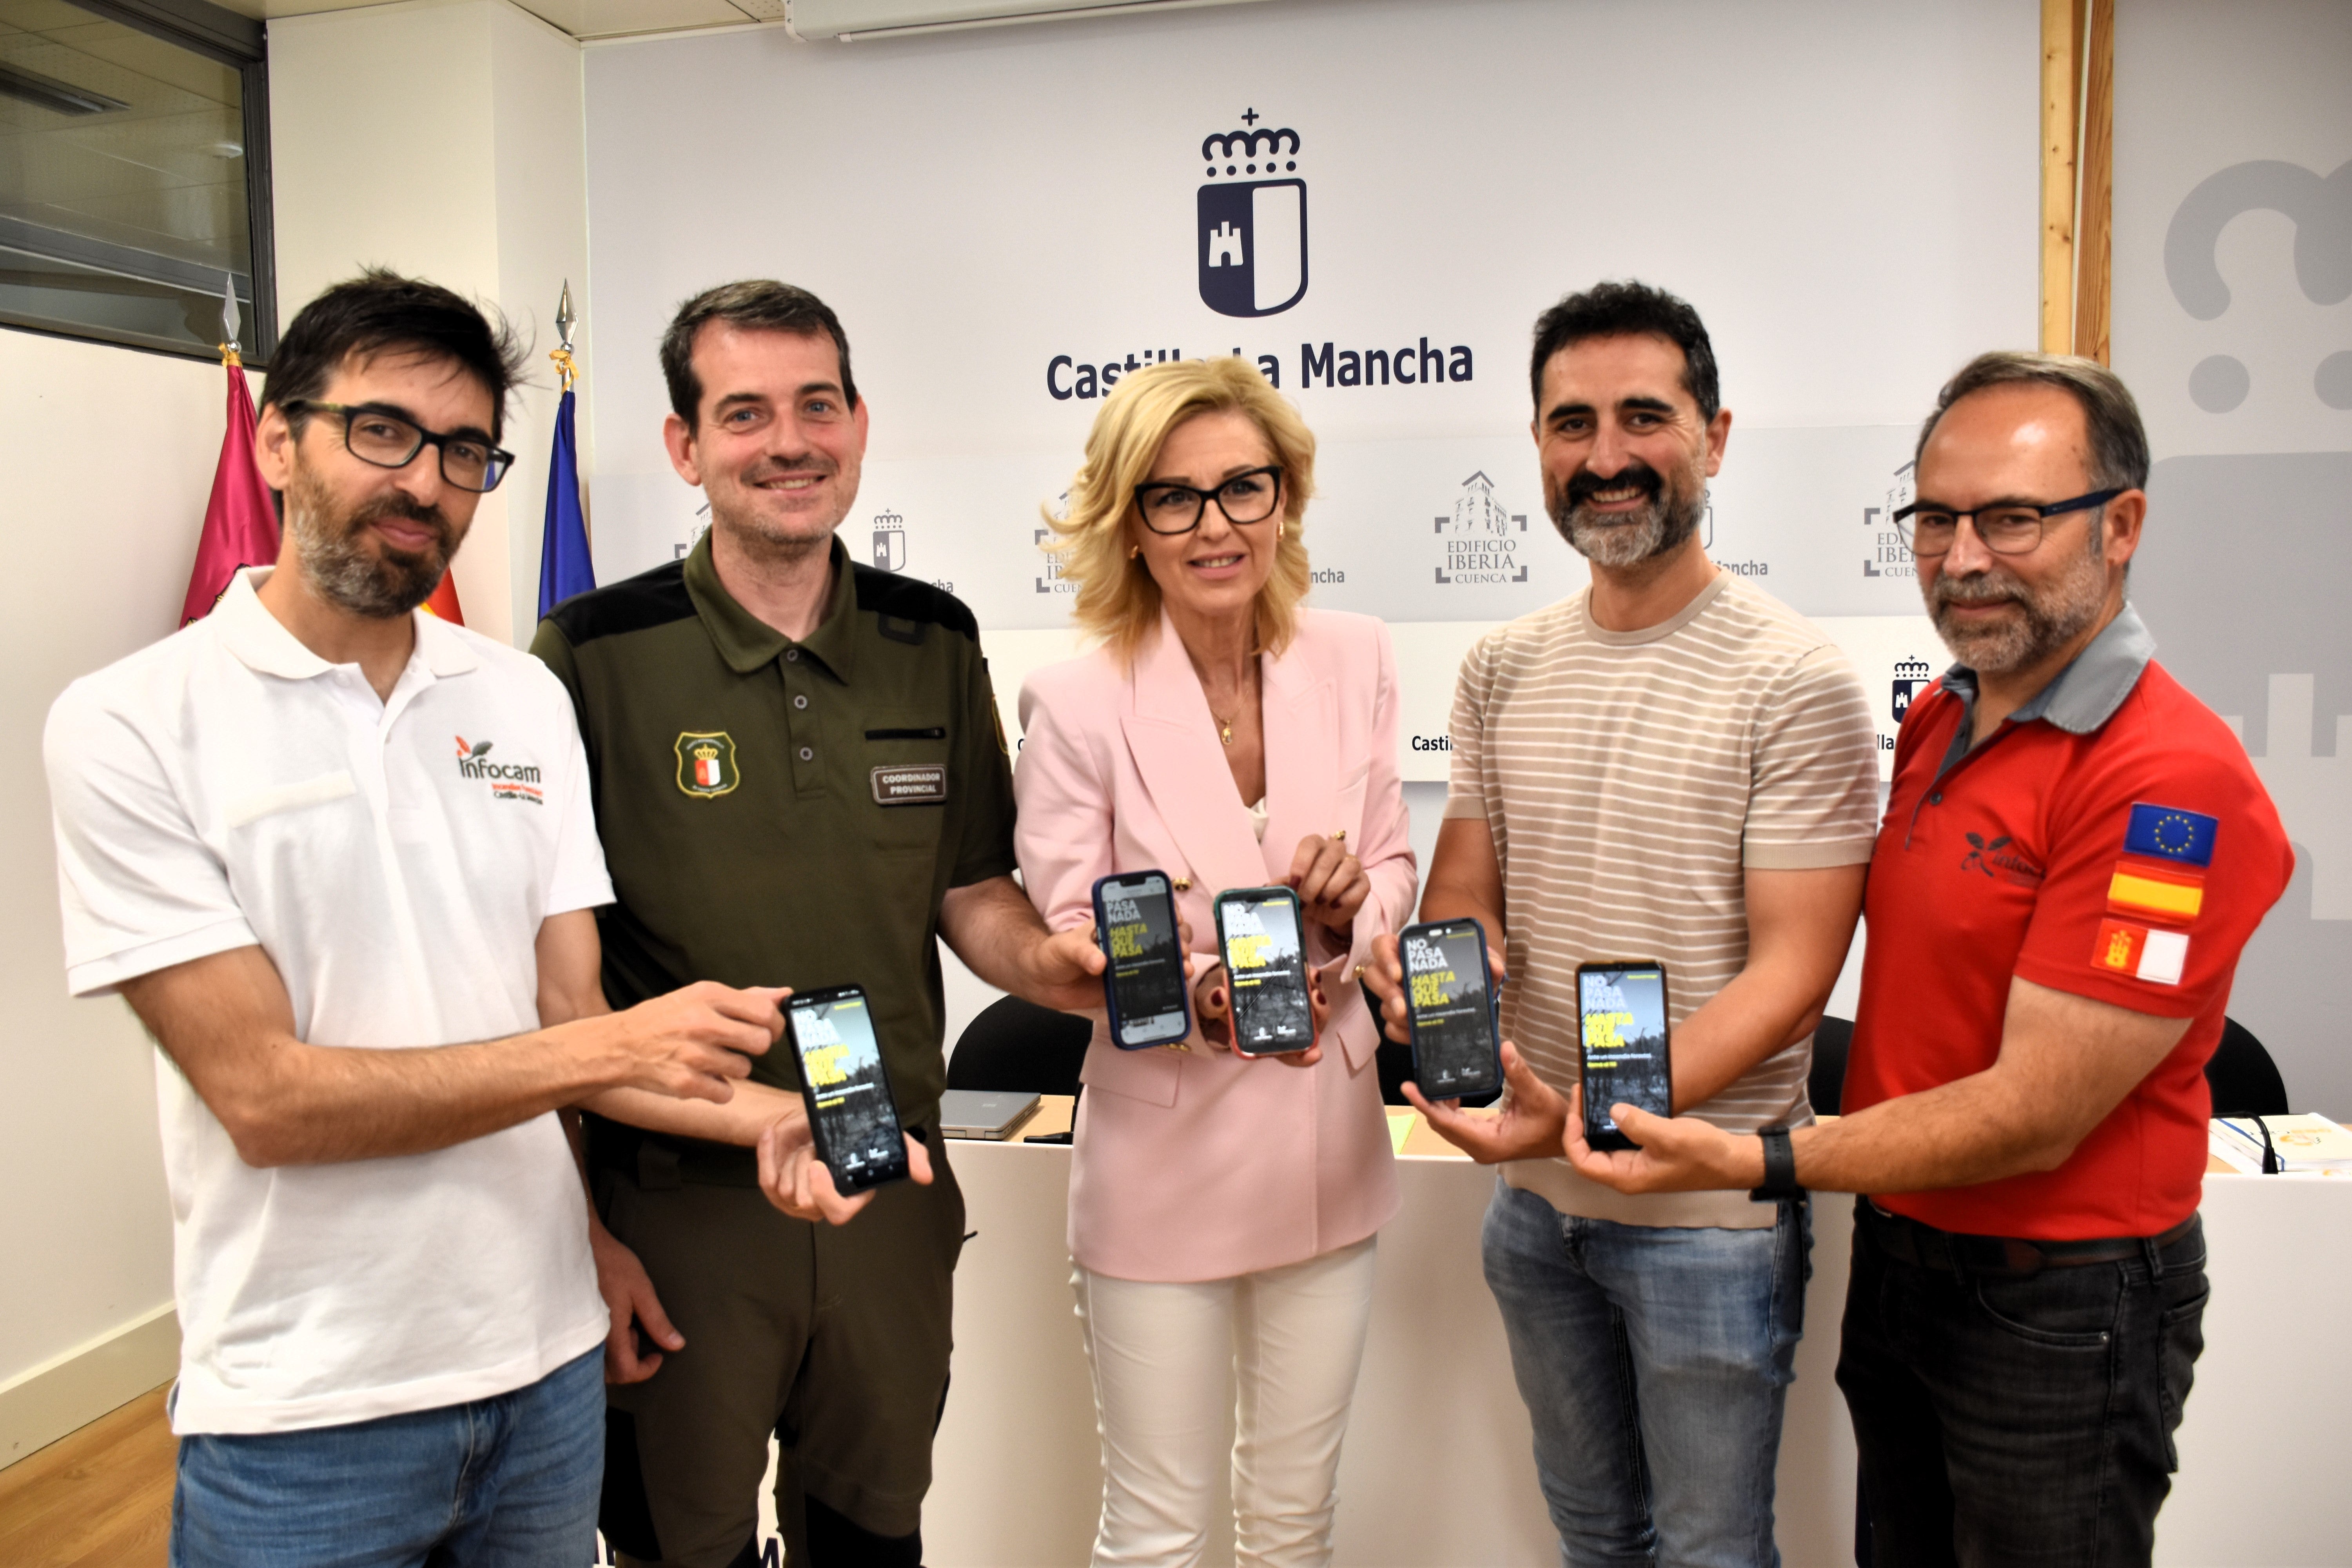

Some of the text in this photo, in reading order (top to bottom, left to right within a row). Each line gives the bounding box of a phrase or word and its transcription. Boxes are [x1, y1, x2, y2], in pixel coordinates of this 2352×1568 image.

[1301, 337, 1473, 389] Mancha
[1448, 540, 1516, 553] EDIFICIO
[1448, 554, 1515, 570] IBERIA
[1455, 573, 1507, 583] CUENCA
[882, 773, 940, 784] COORDINADOR
[890, 784, 937, 795] PROVINCIAL
[1406, 938, 1428, 951] NO
[1408, 947, 1444, 960] PASA
[1410, 957, 1449, 972] NADA
[1411, 970, 1456, 986] HASTA
[1584, 976, 1606, 987] NO
